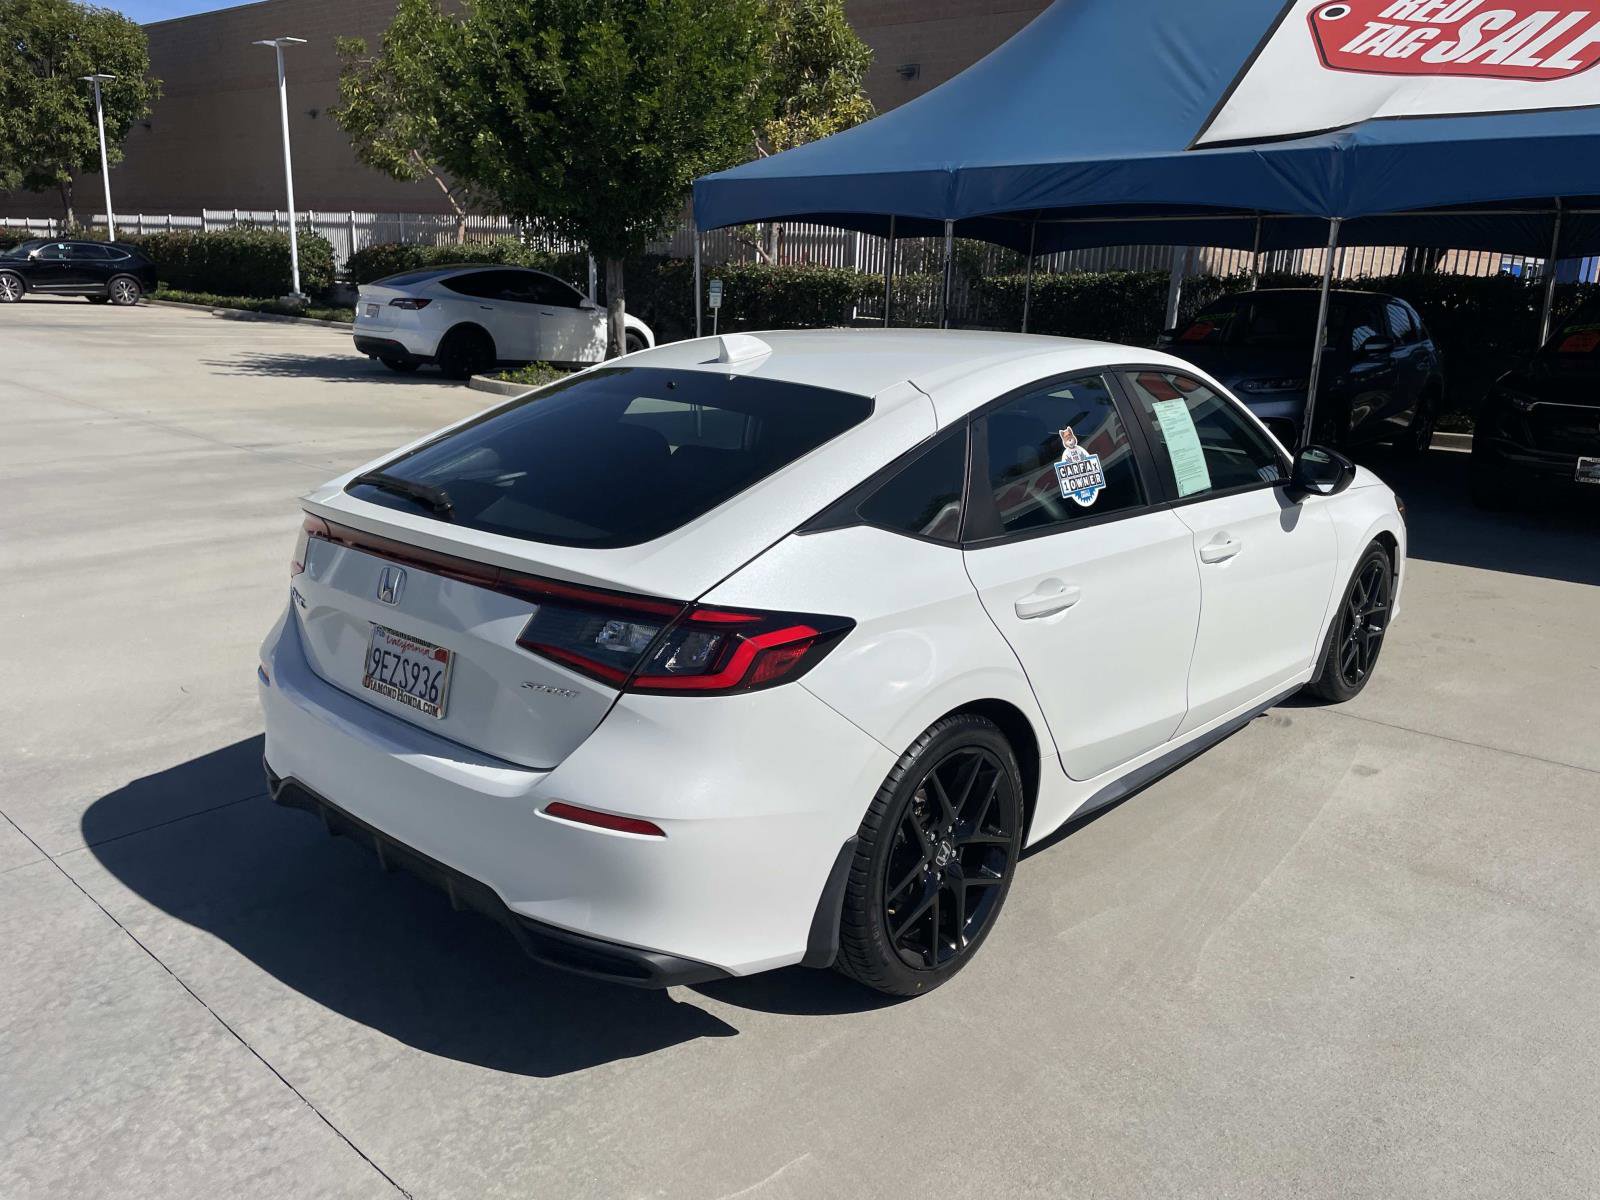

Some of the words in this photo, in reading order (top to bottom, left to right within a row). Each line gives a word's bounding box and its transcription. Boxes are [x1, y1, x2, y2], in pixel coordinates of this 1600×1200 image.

[1339, 21, 1441, 59] TAG
[1060, 461, 1100, 477] CARFAX
[1070, 474, 1102, 490] OWNER
[366, 647, 442, 703] 9EZS936
